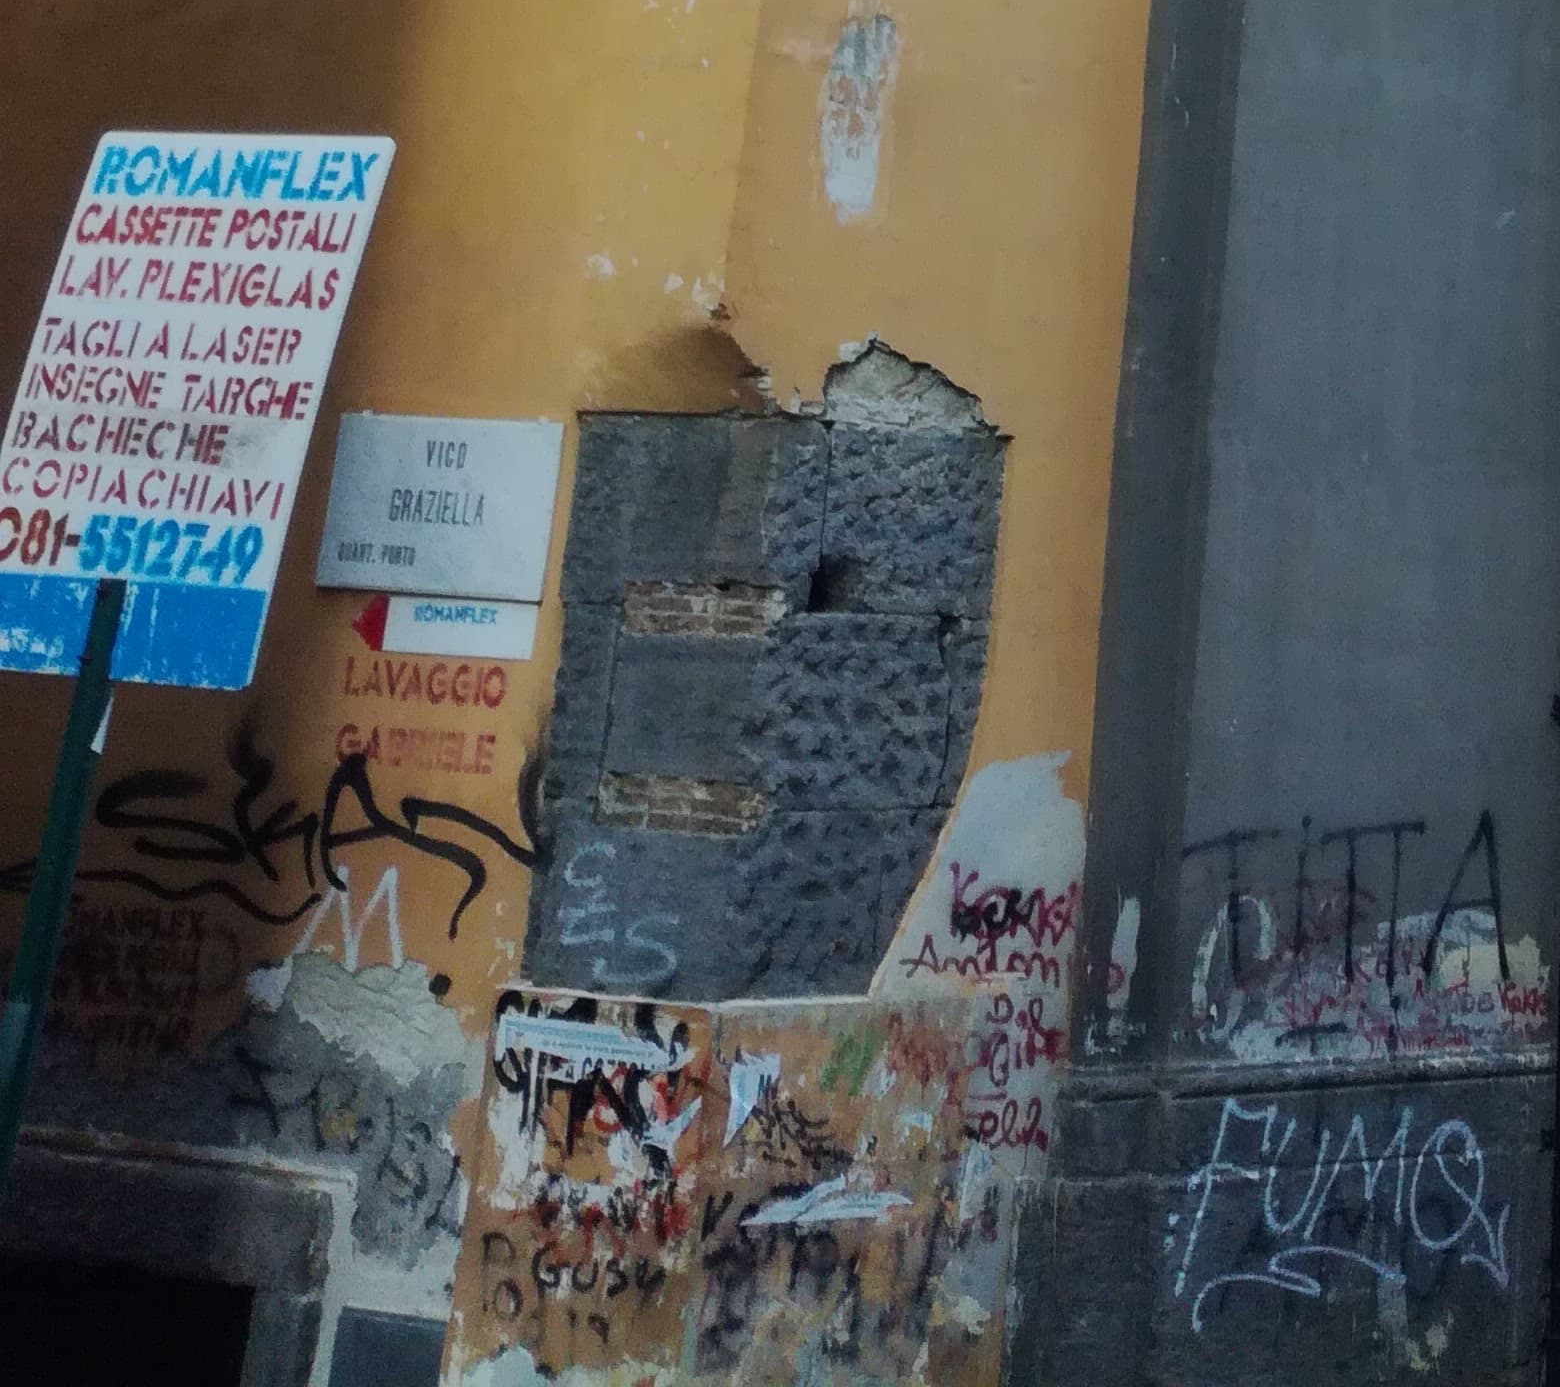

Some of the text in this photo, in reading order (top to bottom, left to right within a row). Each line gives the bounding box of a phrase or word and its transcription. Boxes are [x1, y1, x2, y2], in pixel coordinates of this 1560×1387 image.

[93, 145, 379, 201] ROMANFLEX
[75, 203, 357, 253] CASSETTE POSTALI
[137, 259, 340, 311] PLEXIGLAS
[42, 317, 141, 359] TAGLI
[180, 323, 302, 365] LASER
[25, 363, 314, 420] INSEGNE TARGHE
[11, 410, 230, 466] BACHECHE
[426, 439, 468, 470] VICO
[388, 487, 485, 527] GRAZIELLA
[413, 604, 497, 626] ROMANFLEX
[343, 655, 507, 709] LAVAGGIO
